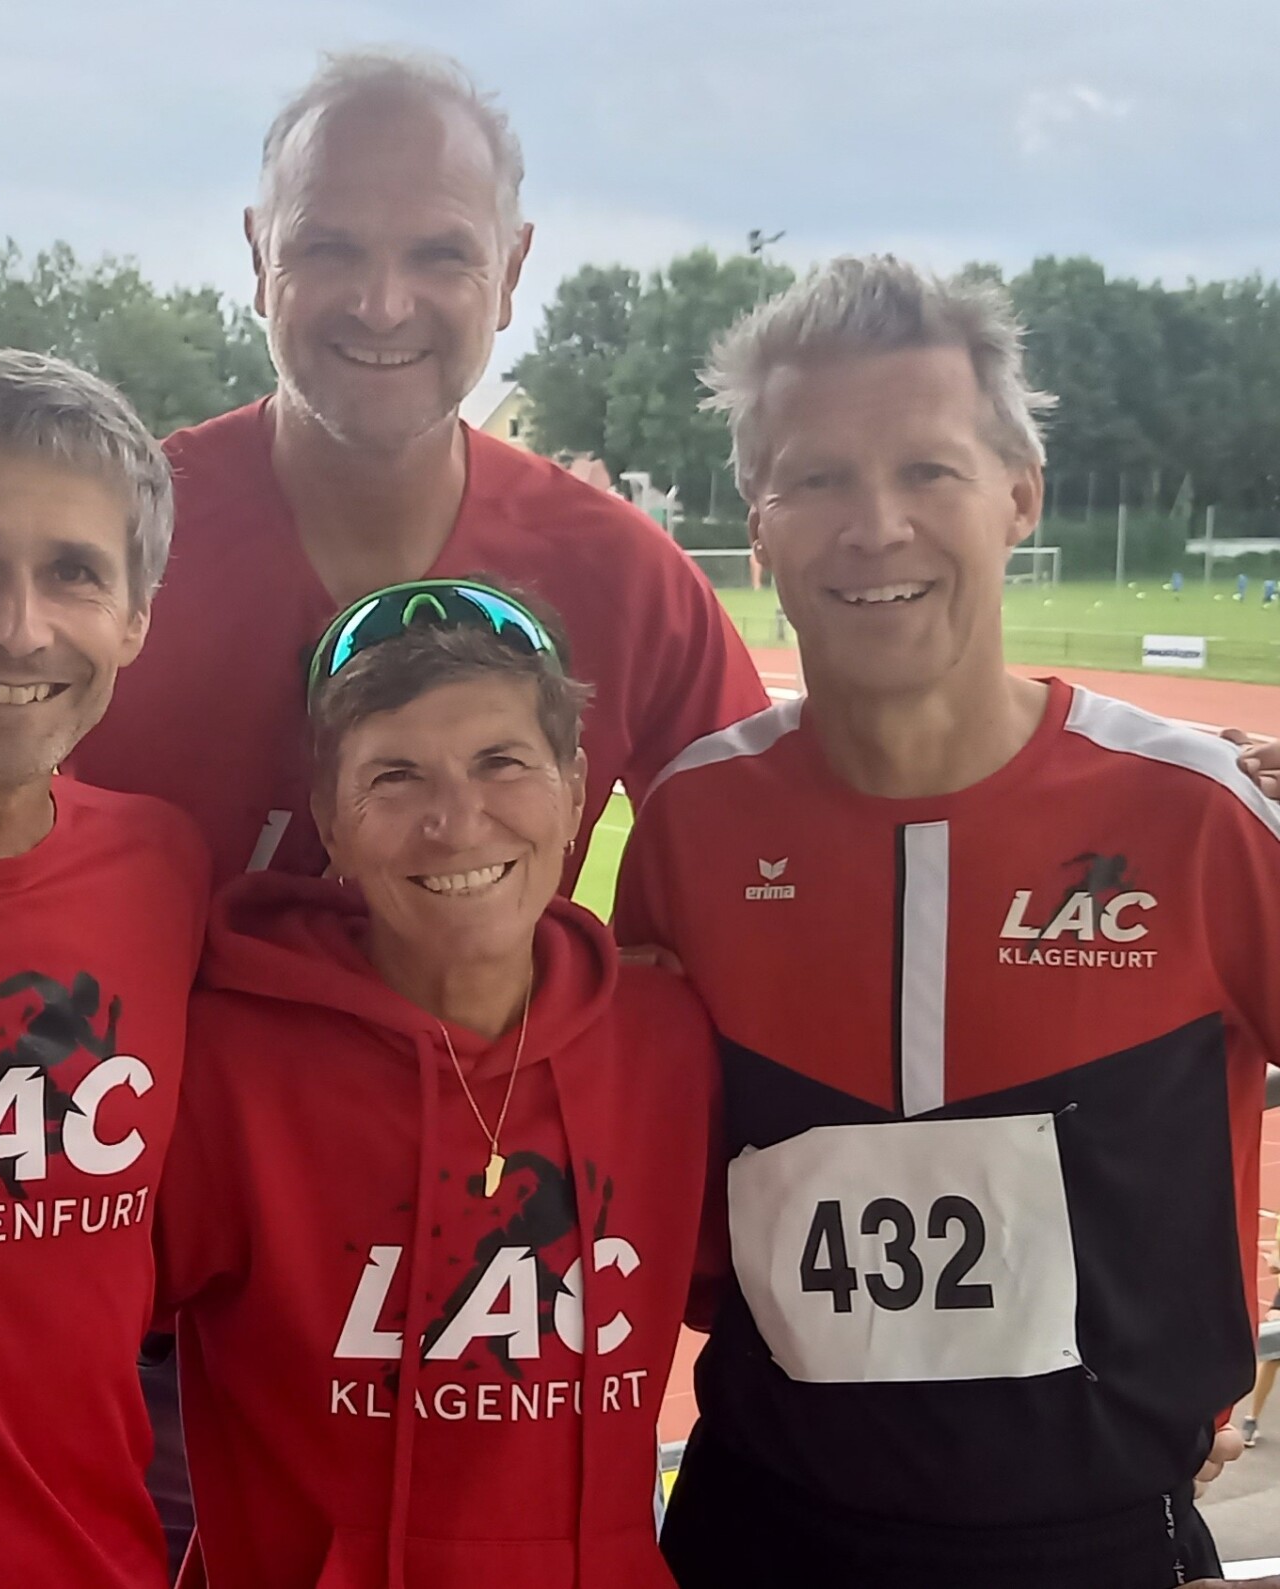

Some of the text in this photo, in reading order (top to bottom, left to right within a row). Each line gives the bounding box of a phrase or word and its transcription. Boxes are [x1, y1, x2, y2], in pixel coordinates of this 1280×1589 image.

[745, 883, 795, 900] erima
[999, 890, 1158, 942] LAC
[999, 947, 1158, 968] KLAGENFURT
[800, 1195, 994, 1313] 432
[333, 1237, 641, 1360] LAC
